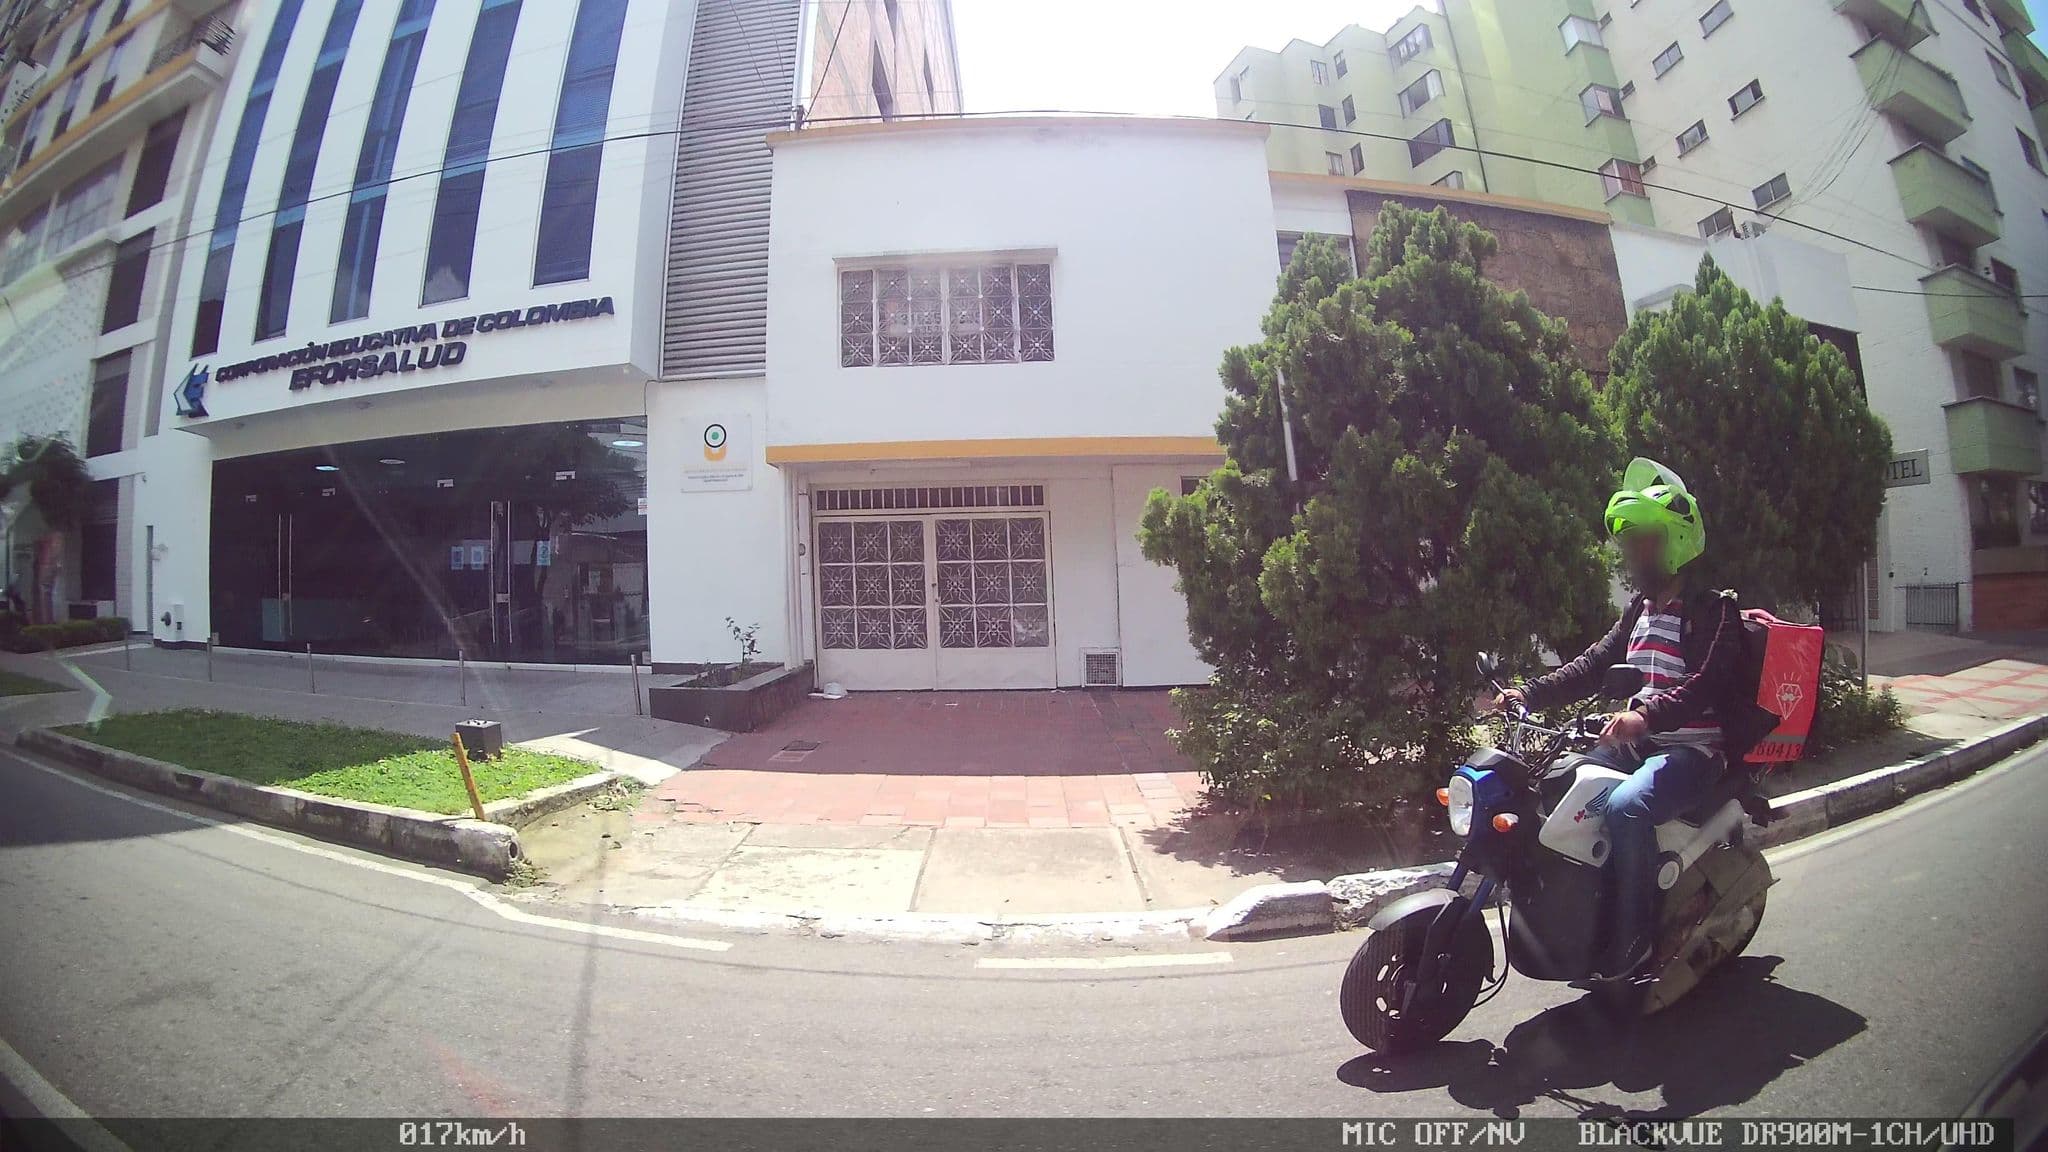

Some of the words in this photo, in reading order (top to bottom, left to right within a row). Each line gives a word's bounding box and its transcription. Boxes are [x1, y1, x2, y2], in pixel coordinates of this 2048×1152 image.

[215, 341, 328, 383] CORPORACIÓN
[328, 323, 437, 357] EDUCATIVA
[441, 316, 476, 338] DE
[476, 296, 614, 333] COLOMBIA
[289, 341, 467, 390] EFORSALUD
[1887, 458, 1921, 480] TEL
